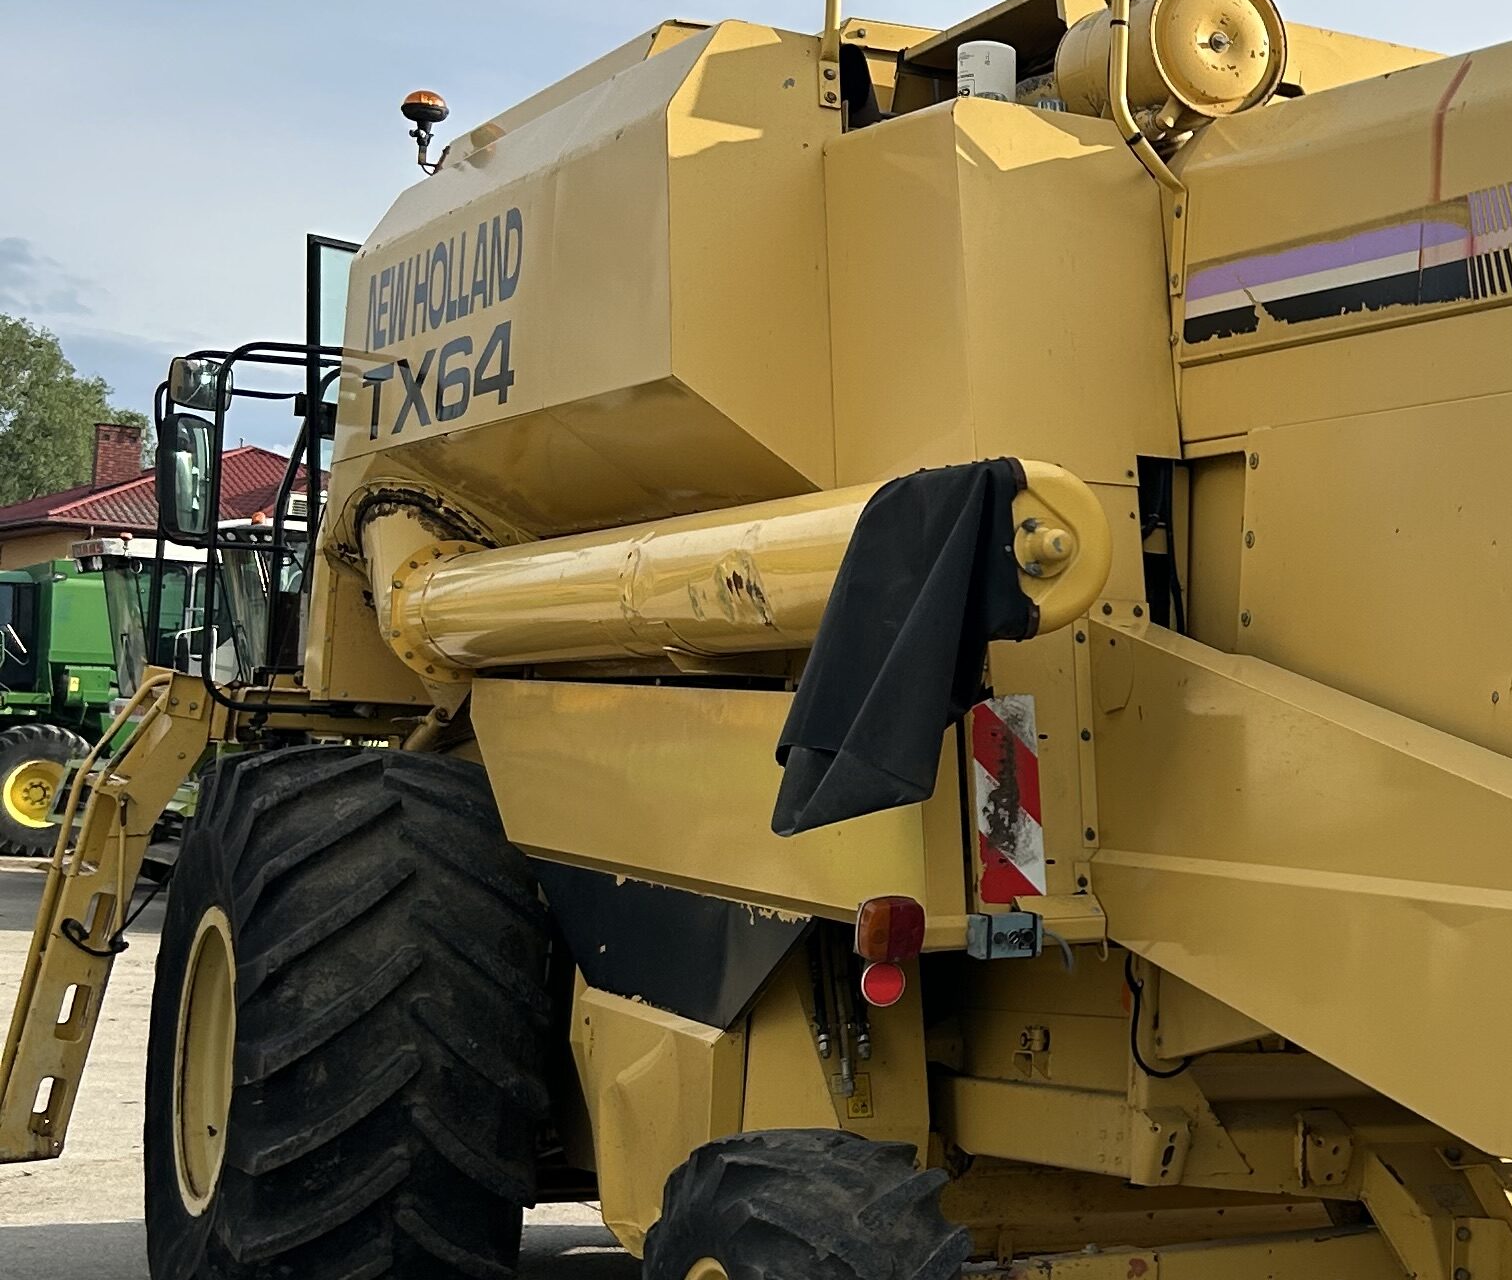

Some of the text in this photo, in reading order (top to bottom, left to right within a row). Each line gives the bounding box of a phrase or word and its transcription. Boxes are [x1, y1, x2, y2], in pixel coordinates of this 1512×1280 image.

[365, 206, 524, 354] NEW HOLLAND
[362, 319, 515, 441] TX64
